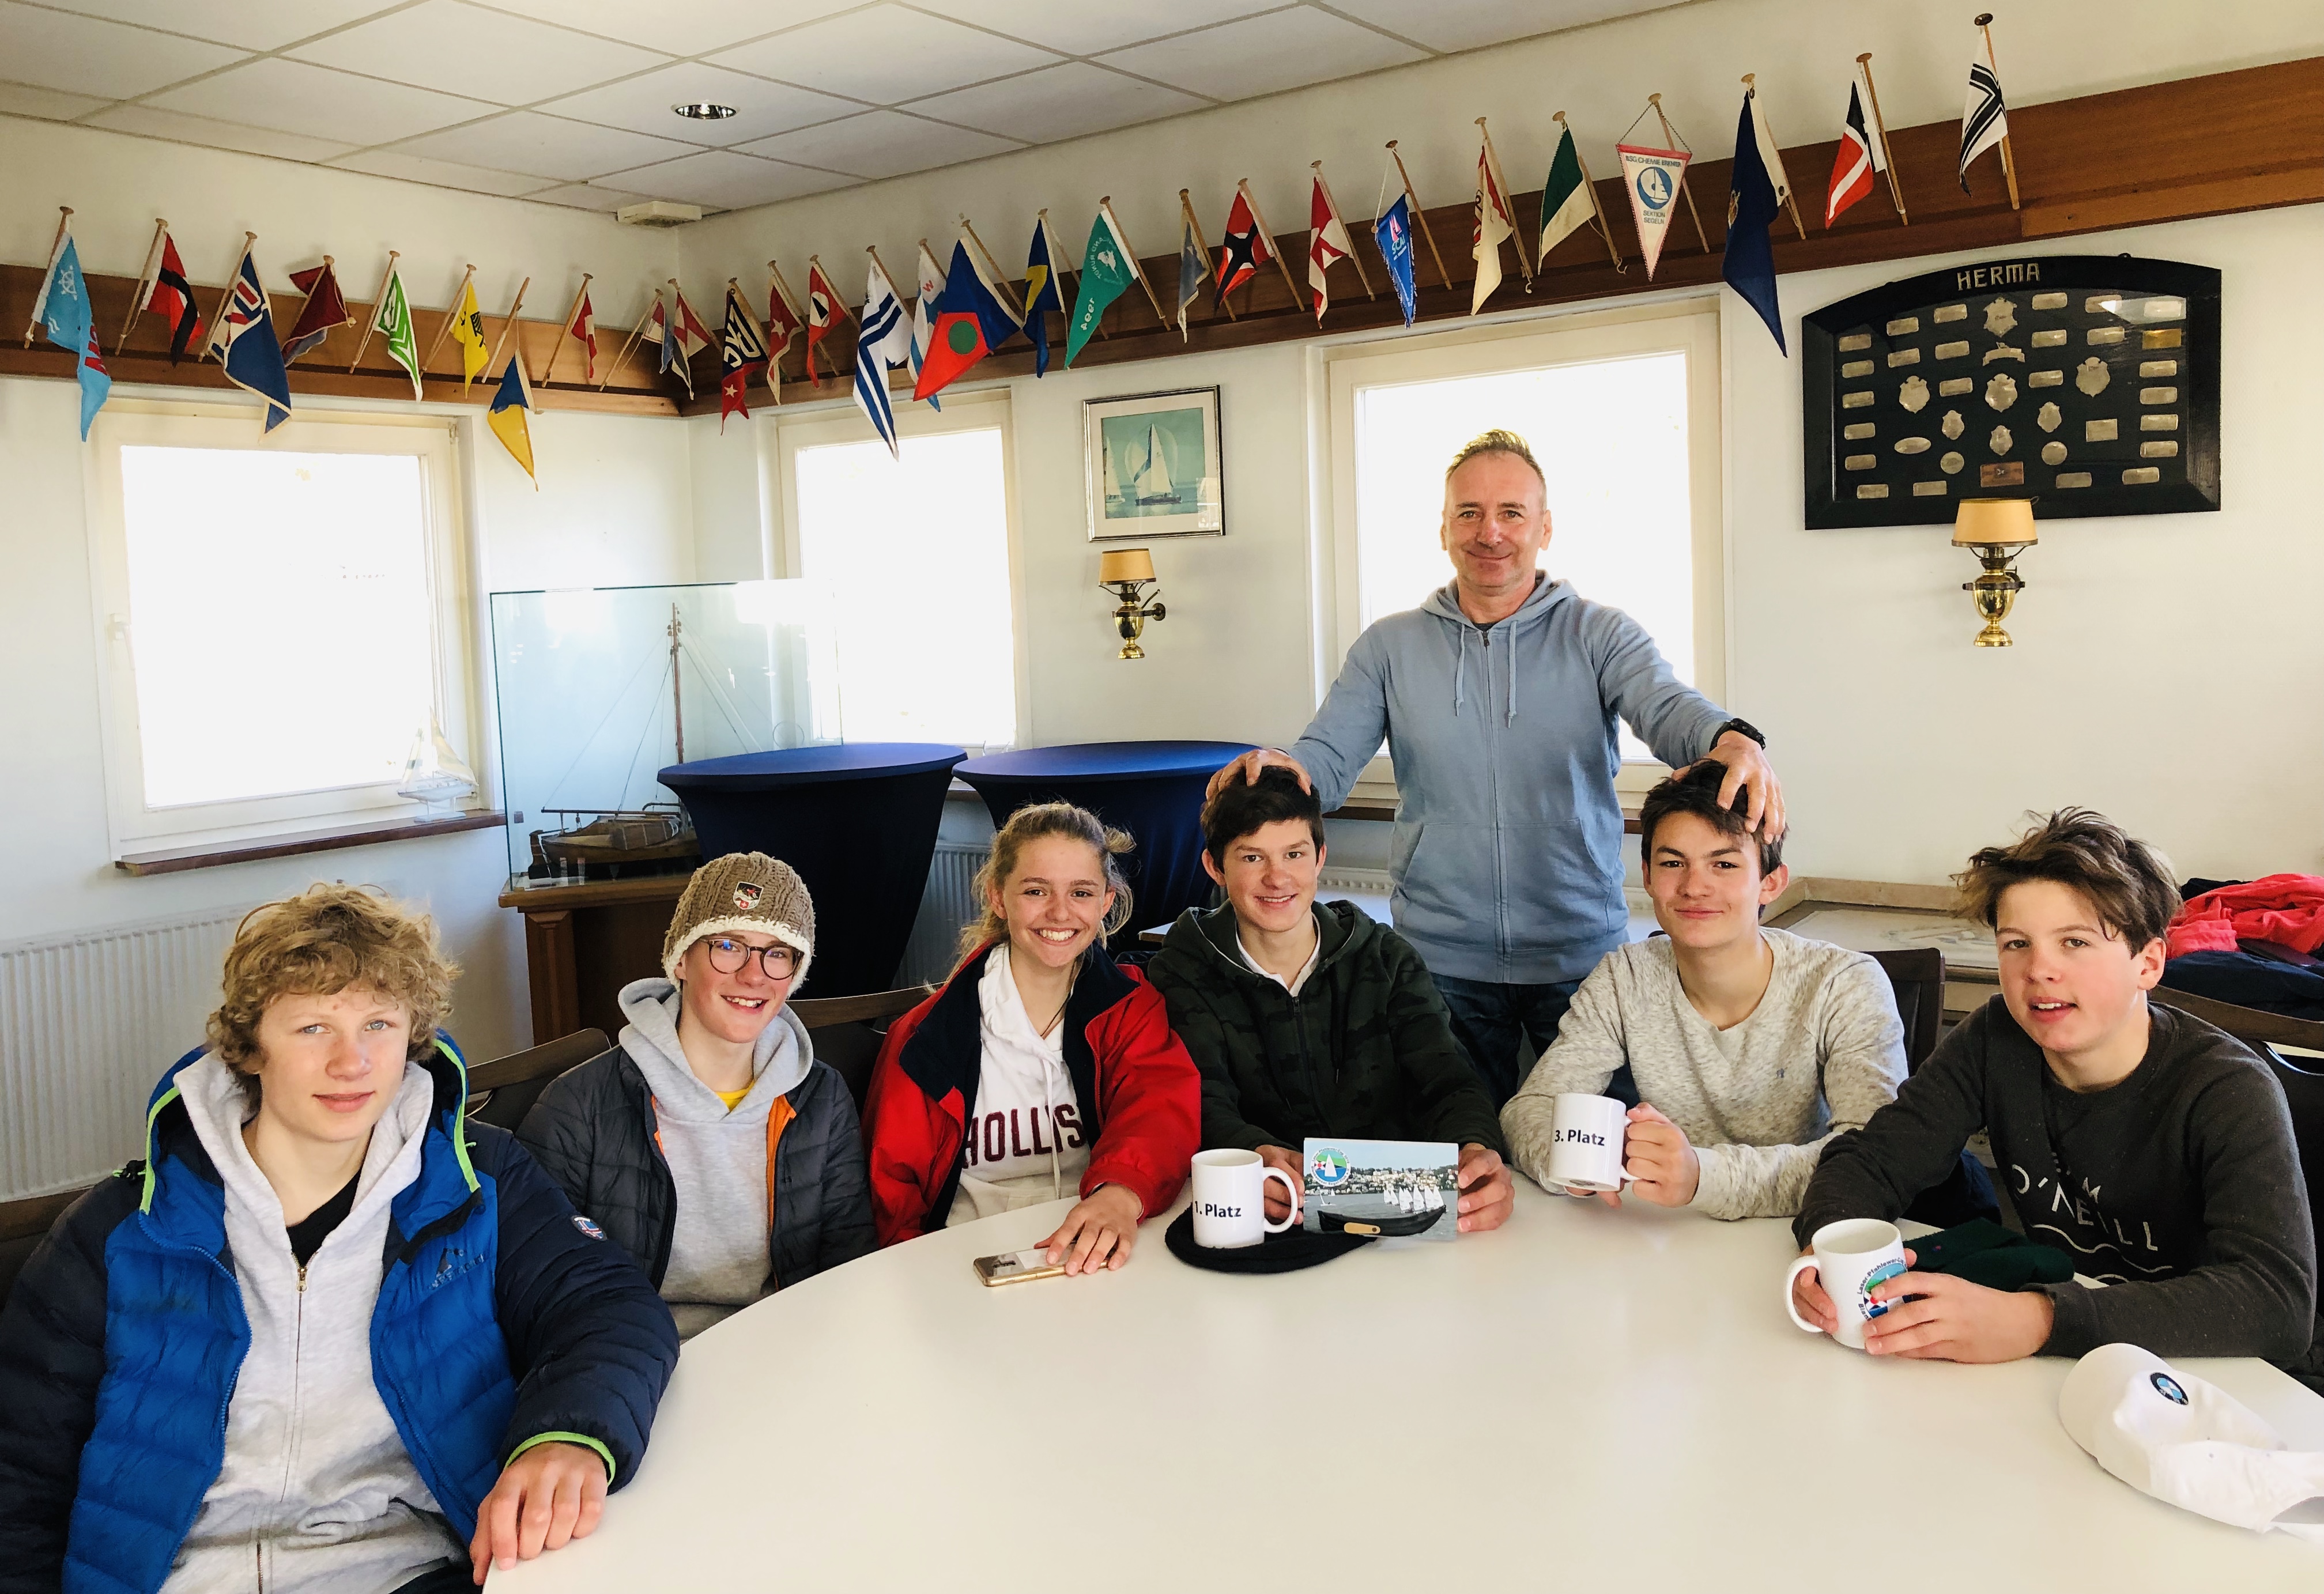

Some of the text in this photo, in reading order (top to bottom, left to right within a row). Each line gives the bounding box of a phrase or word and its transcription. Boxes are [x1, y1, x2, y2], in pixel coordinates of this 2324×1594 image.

[1643, 210, 1665, 218] SEKTION
[1957, 262, 2040, 291] HERMA
[1555, 1129, 1605, 1146] 3. Platz
[1195, 1200, 1242, 1217] 1. Platz
